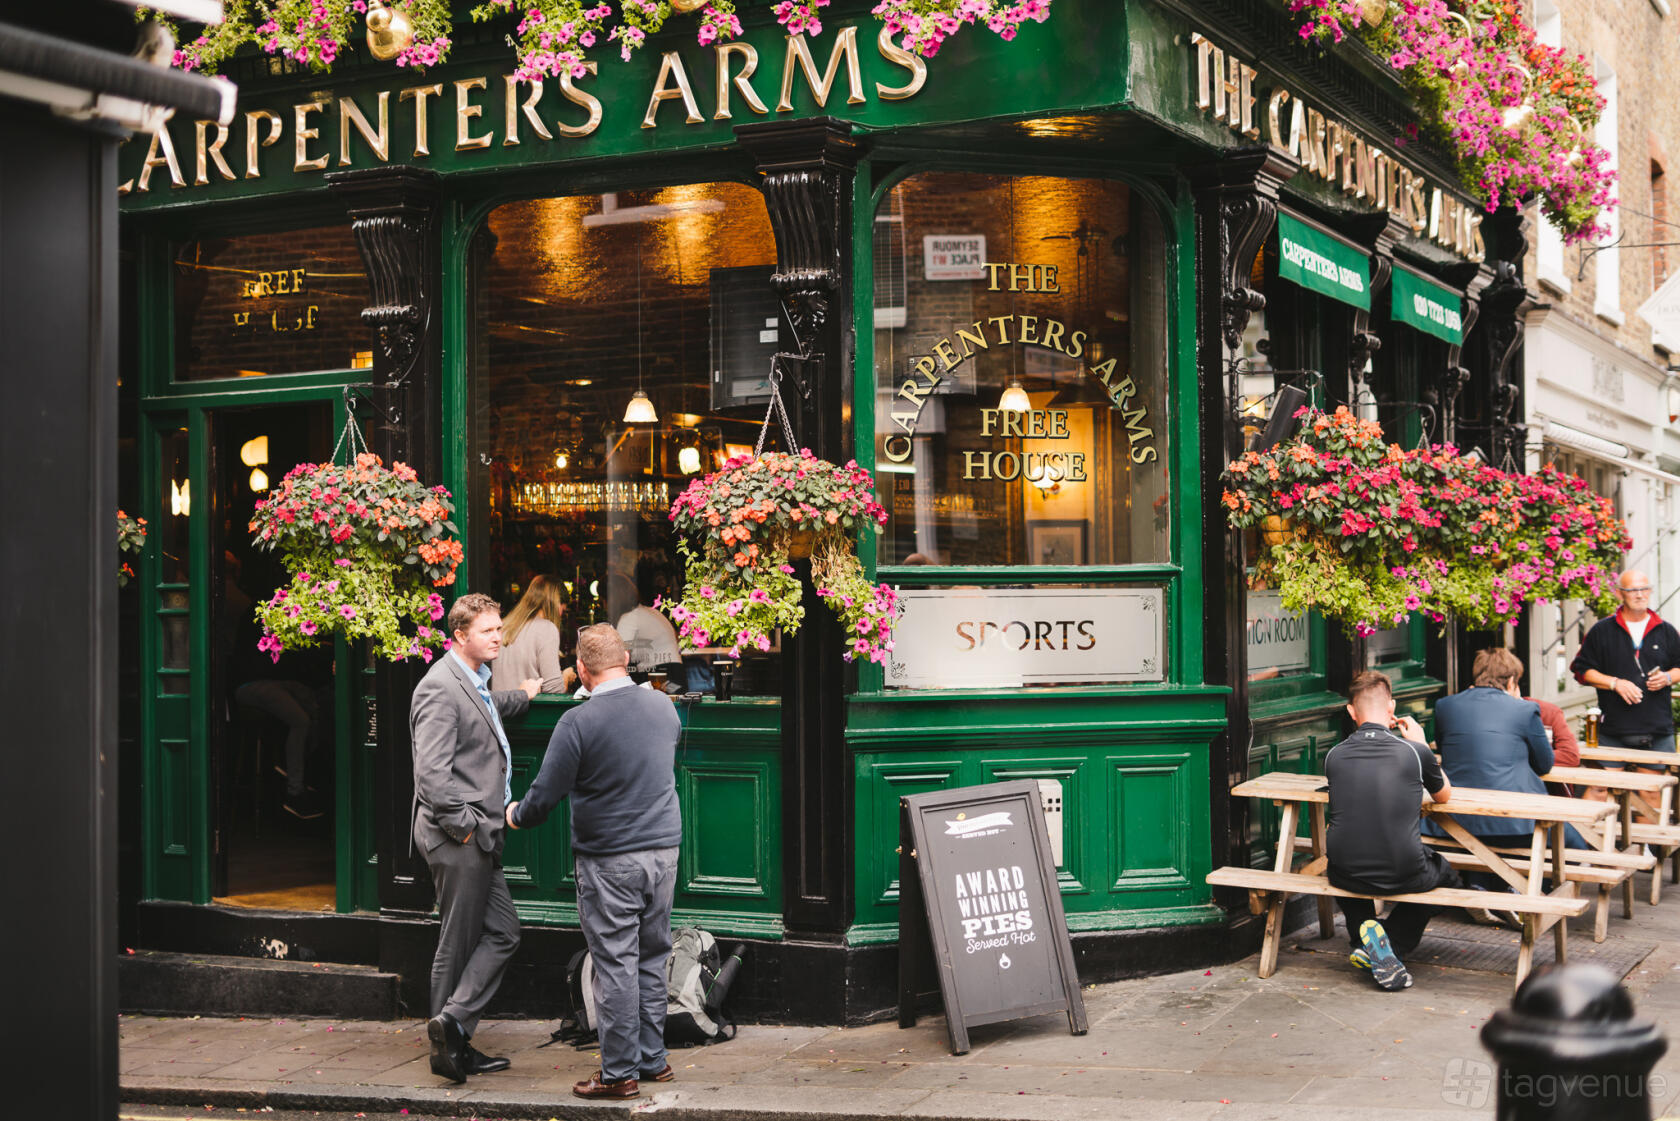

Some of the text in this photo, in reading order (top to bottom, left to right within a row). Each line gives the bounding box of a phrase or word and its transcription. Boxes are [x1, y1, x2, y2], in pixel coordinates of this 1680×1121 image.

[118, 26, 928, 194] ARPENTERS ARMS
[1192, 31, 1261, 141] THE
[1429, 187, 1486, 263] ARMS
[1282, 238, 1338, 283] CARPENTERS
[981, 262, 1060, 293] THE
[884, 314, 1158, 465] CARPENTERS ARMS
[980, 408, 1070, 439] FREE
[963, 451, 1088, 481] HOUSE
[956, 619, 1096, 651] SPORTS
[1275, 616, 1305, 643] ROOM
[955, 866, 1025, 898] AWARD
[958, 890, 1029, 918] WINNING
[961, 910, 1033, 939] PIES
[966, 931, 1036, 954] Served Hot
